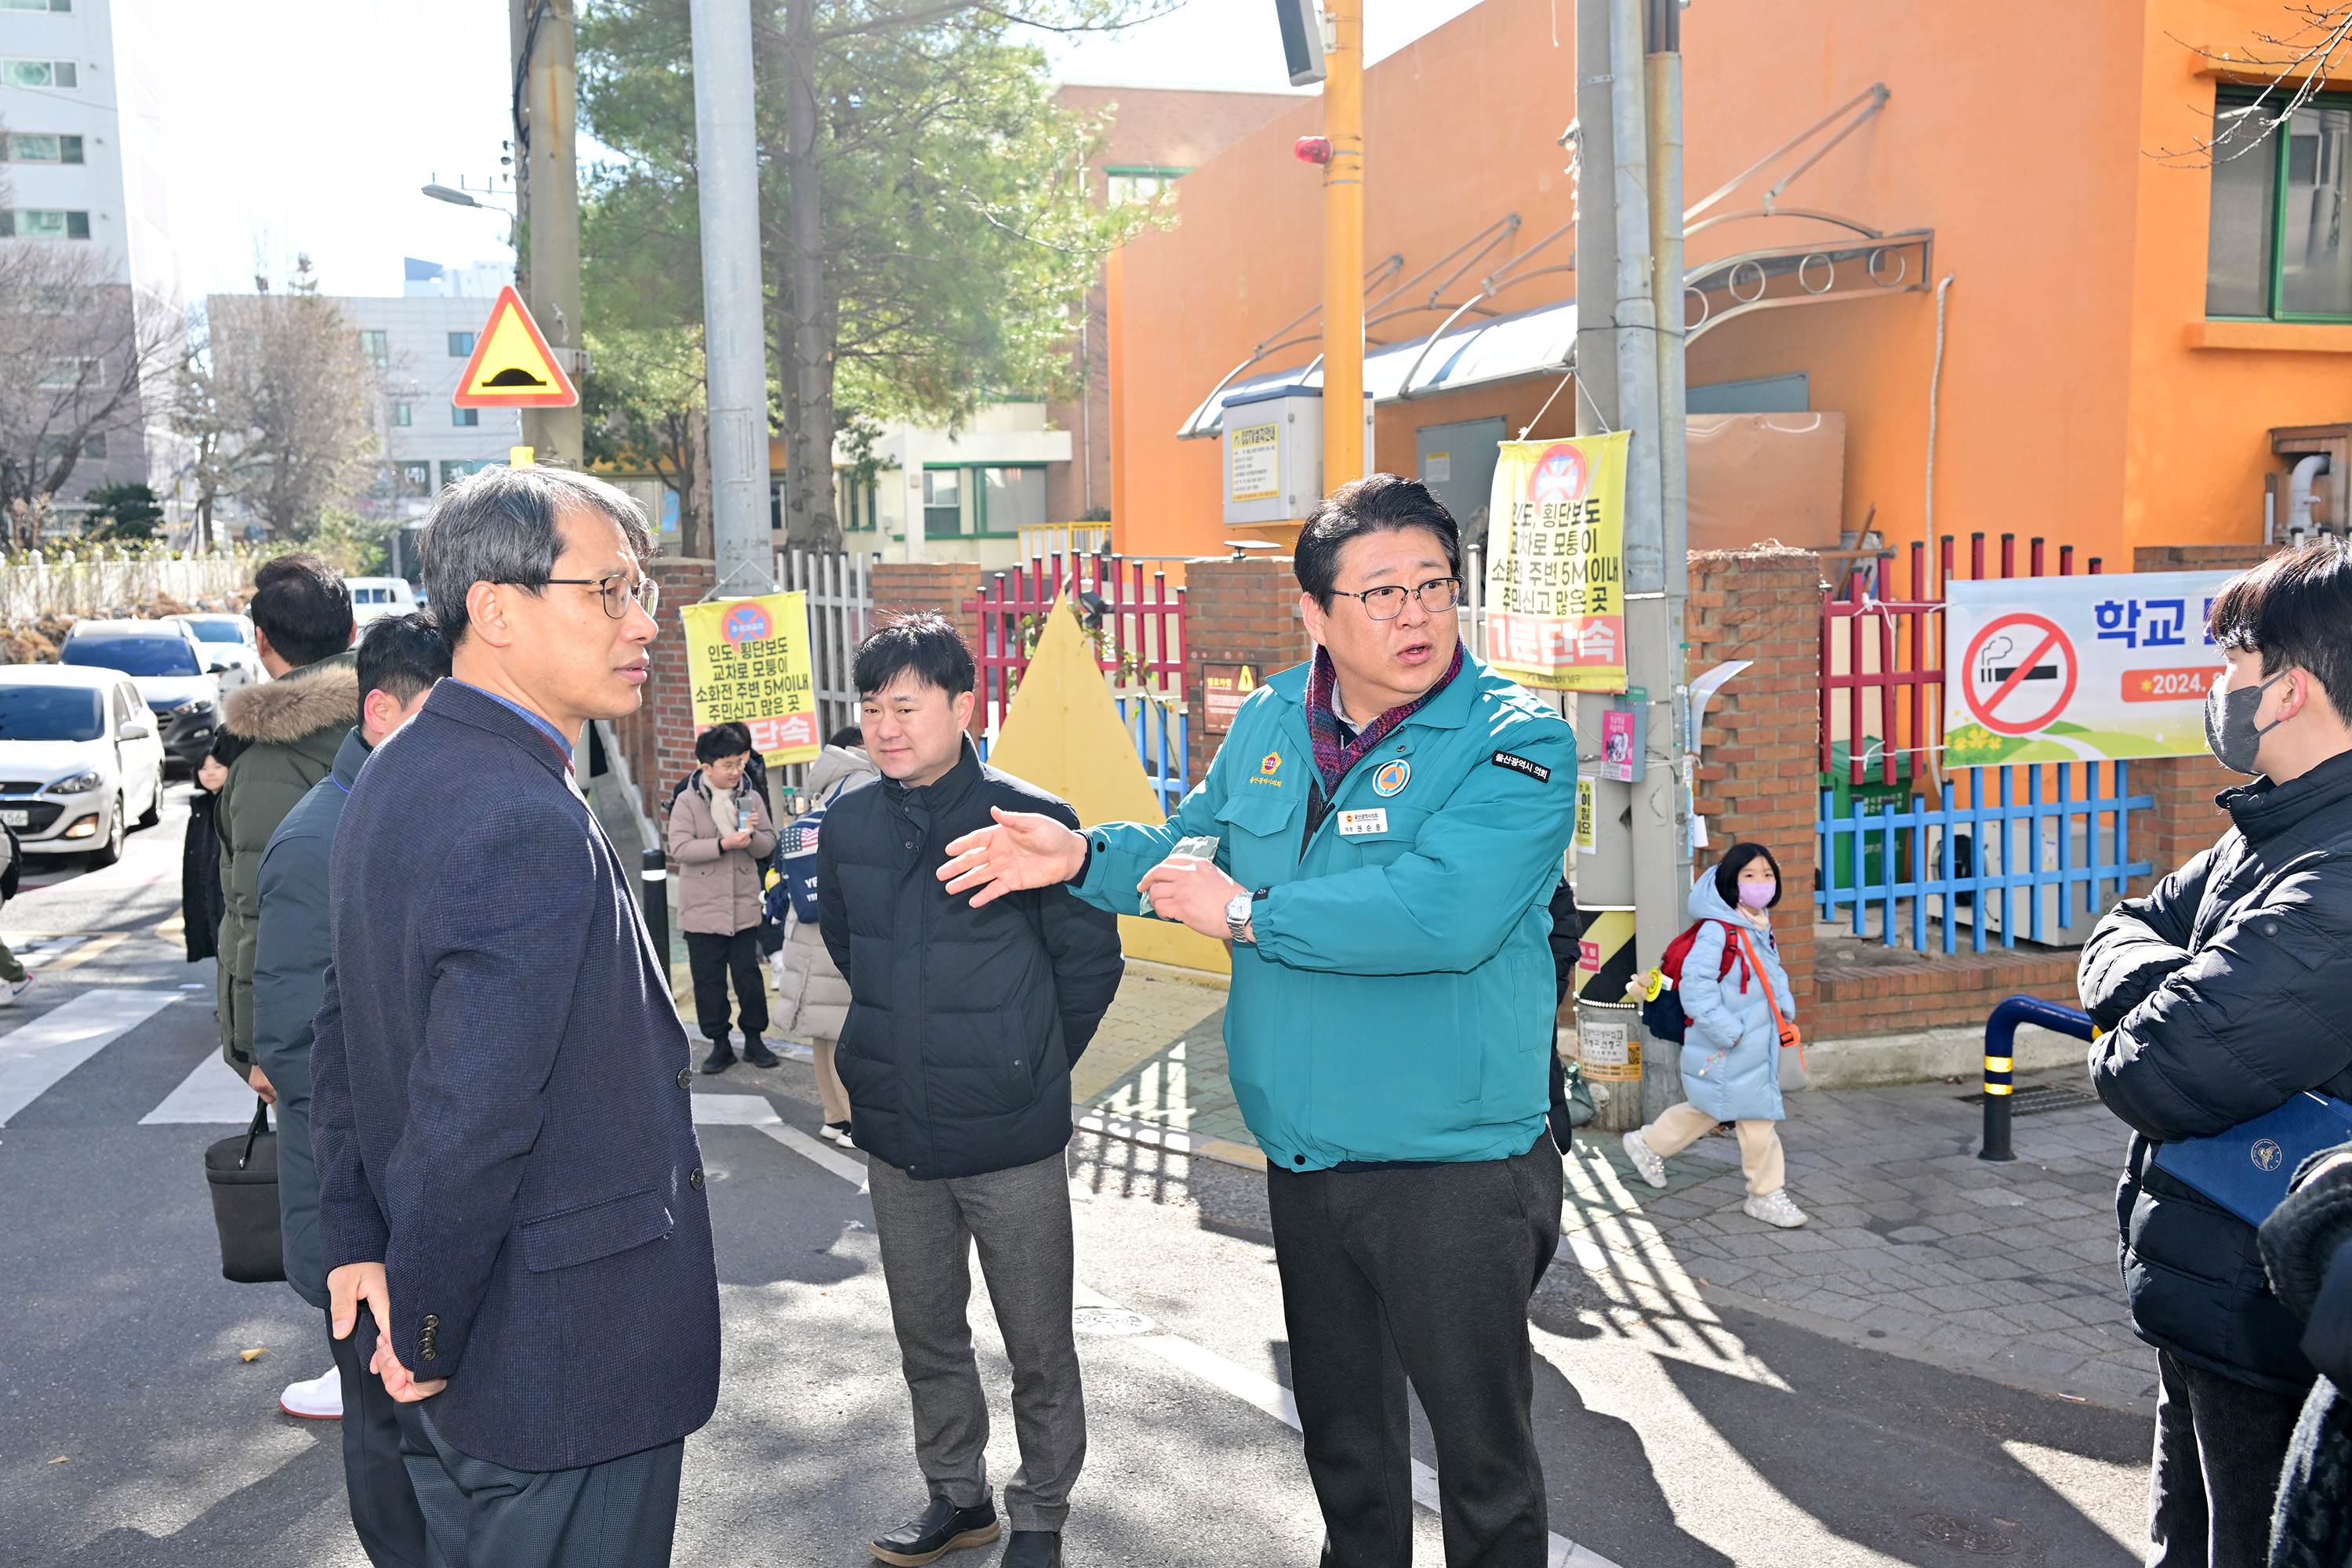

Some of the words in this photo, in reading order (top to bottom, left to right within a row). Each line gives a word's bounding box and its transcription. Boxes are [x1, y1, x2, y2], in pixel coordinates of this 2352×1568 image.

[1543, 499, 1600, 528] 횡단보도
[1553, 528, 1596, 556] 모퉁이
[1529, 561, 1556, 586] 주변
[1562, 557, 1618, 586] 5M이내
[1503, 587, 1550, 615] 주민신고
[1556, 589, 1586, 615] 많은
[1592, 587, 1607, 612] 곳
[2095, 600, 2185, 648] 학교
[708, 644, 737, 662] 인도,
[740, 637, 789, 659] 횡단보도
[713, 662, 749, 681] 교차로
[753, 656, 788, 677] 모퉁이
[696, 684, 732, 703] 소화전
[737, 681, 760, 699] 주변
[764, 673, 809, 696] 5M이내
[709, 702, 757, 721] 주민신고
[760, 697, 783, 717] 많은
[787, 694, 800, 712] 곳
[1496, 753, 1534, 772] 울산광역시
[1534, 766, 1548, 779] 의회
